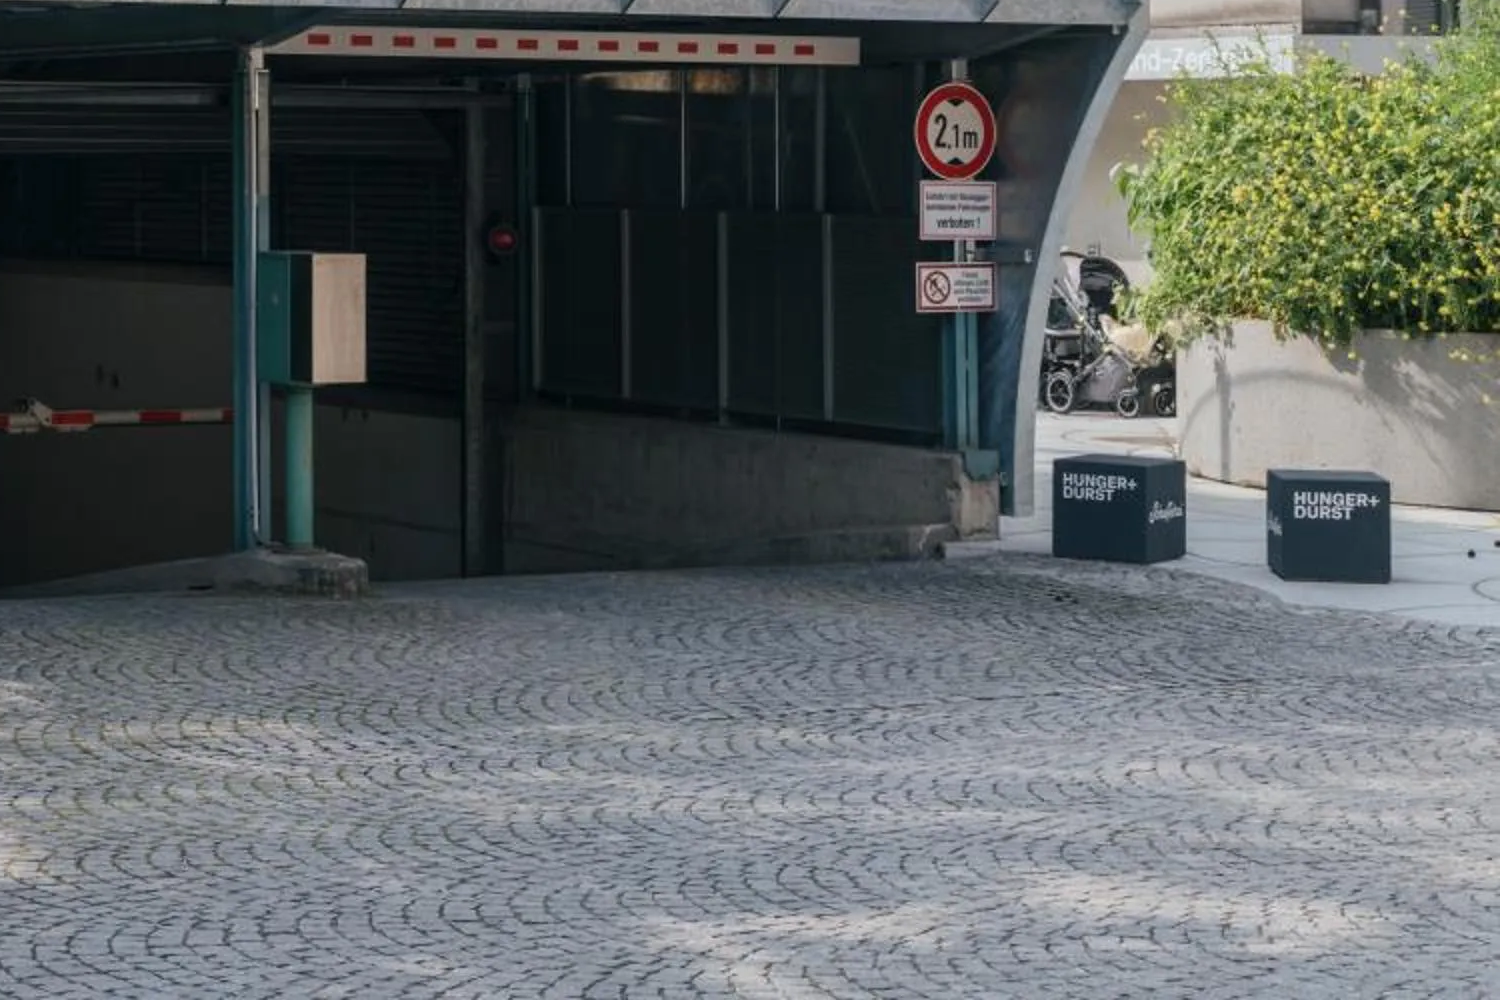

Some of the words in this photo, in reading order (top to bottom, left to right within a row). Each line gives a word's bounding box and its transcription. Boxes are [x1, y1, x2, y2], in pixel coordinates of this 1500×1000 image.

[1062, 472, 1138, 490] HUNGER+
[1062, 486, 1115, 501] DURST
[1293, 491, 1380, 508] HUNGER+
[1293, 505, 1352, 520] DURST
